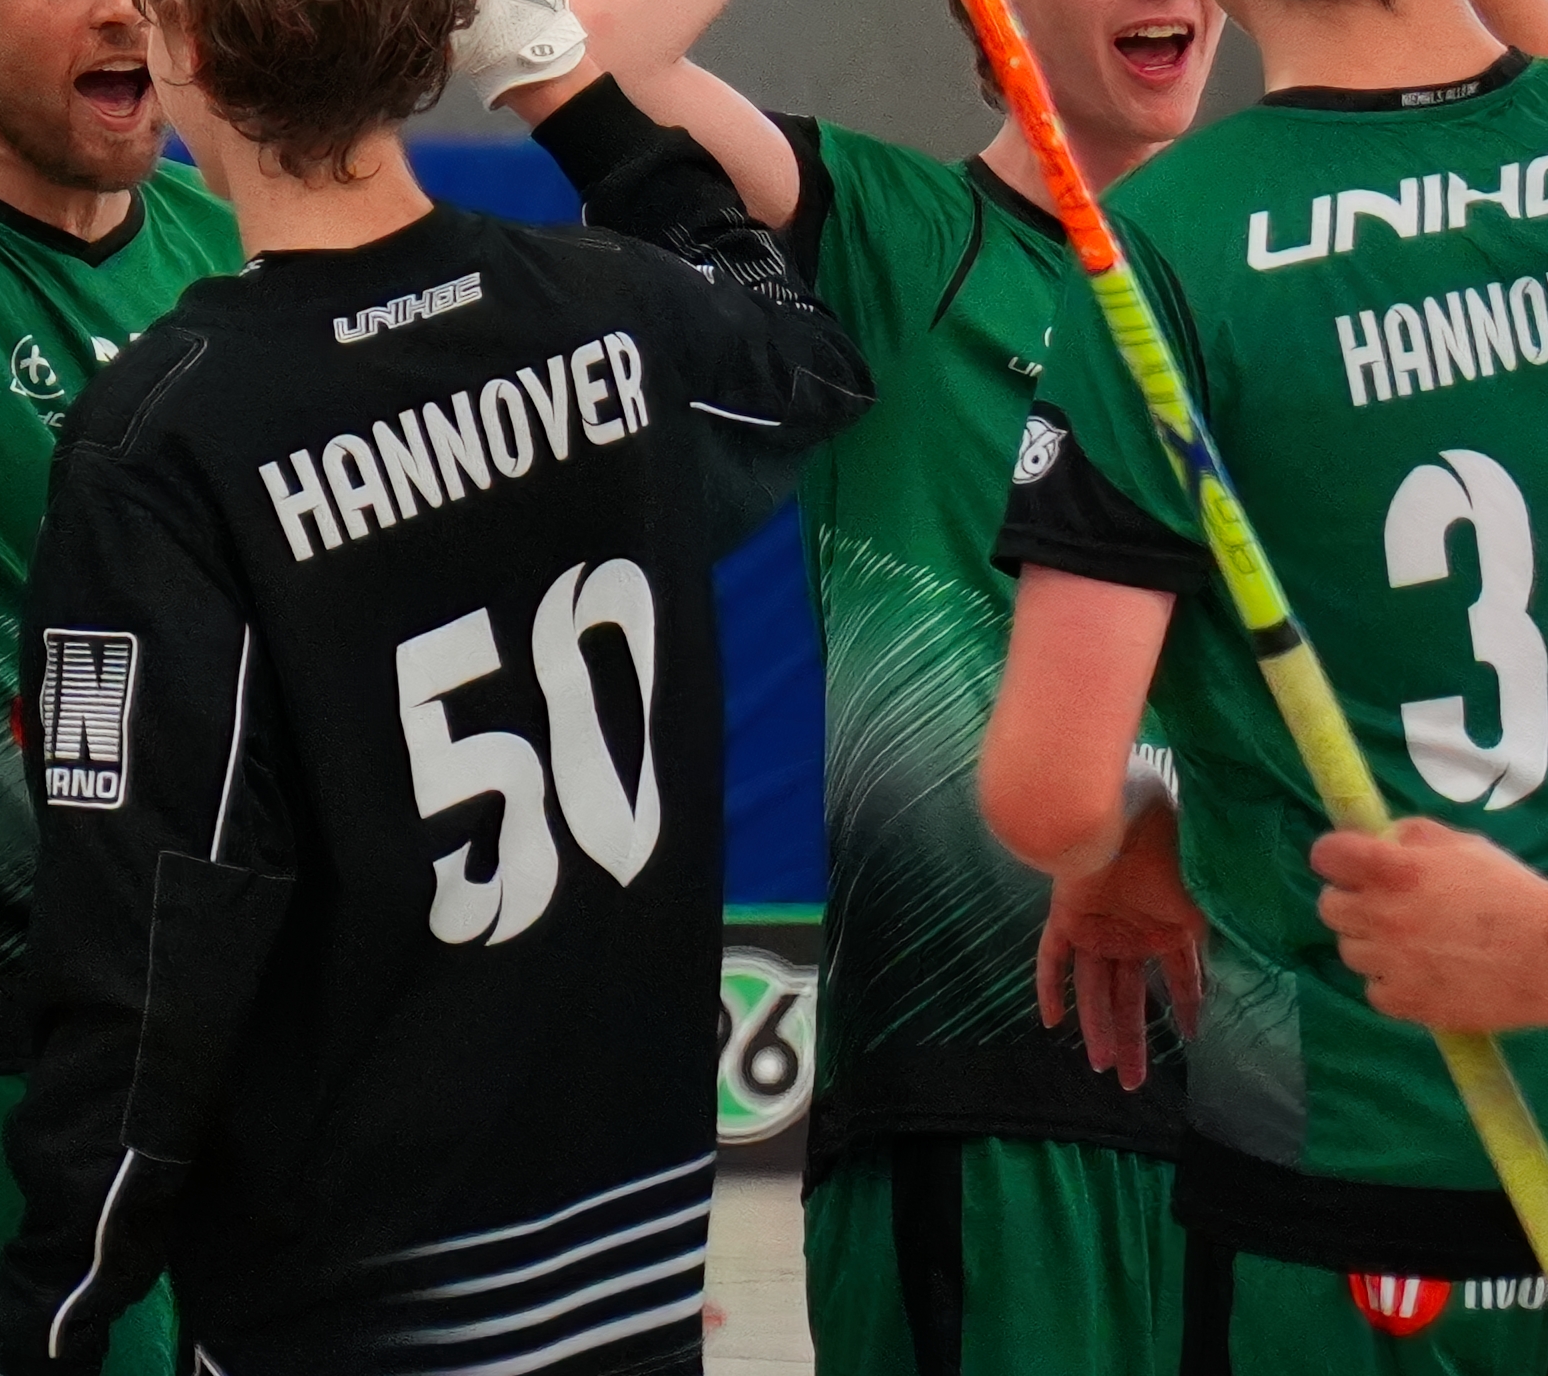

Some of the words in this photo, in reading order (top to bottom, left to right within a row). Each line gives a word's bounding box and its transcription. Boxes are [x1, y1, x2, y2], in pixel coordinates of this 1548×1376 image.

[333, 272, 483, 344] UNIHOC
[259, 331, 649, 561] HANNOVER
[396, 558, 661, 947] 50
[719, 993, 800, 1097] 6
